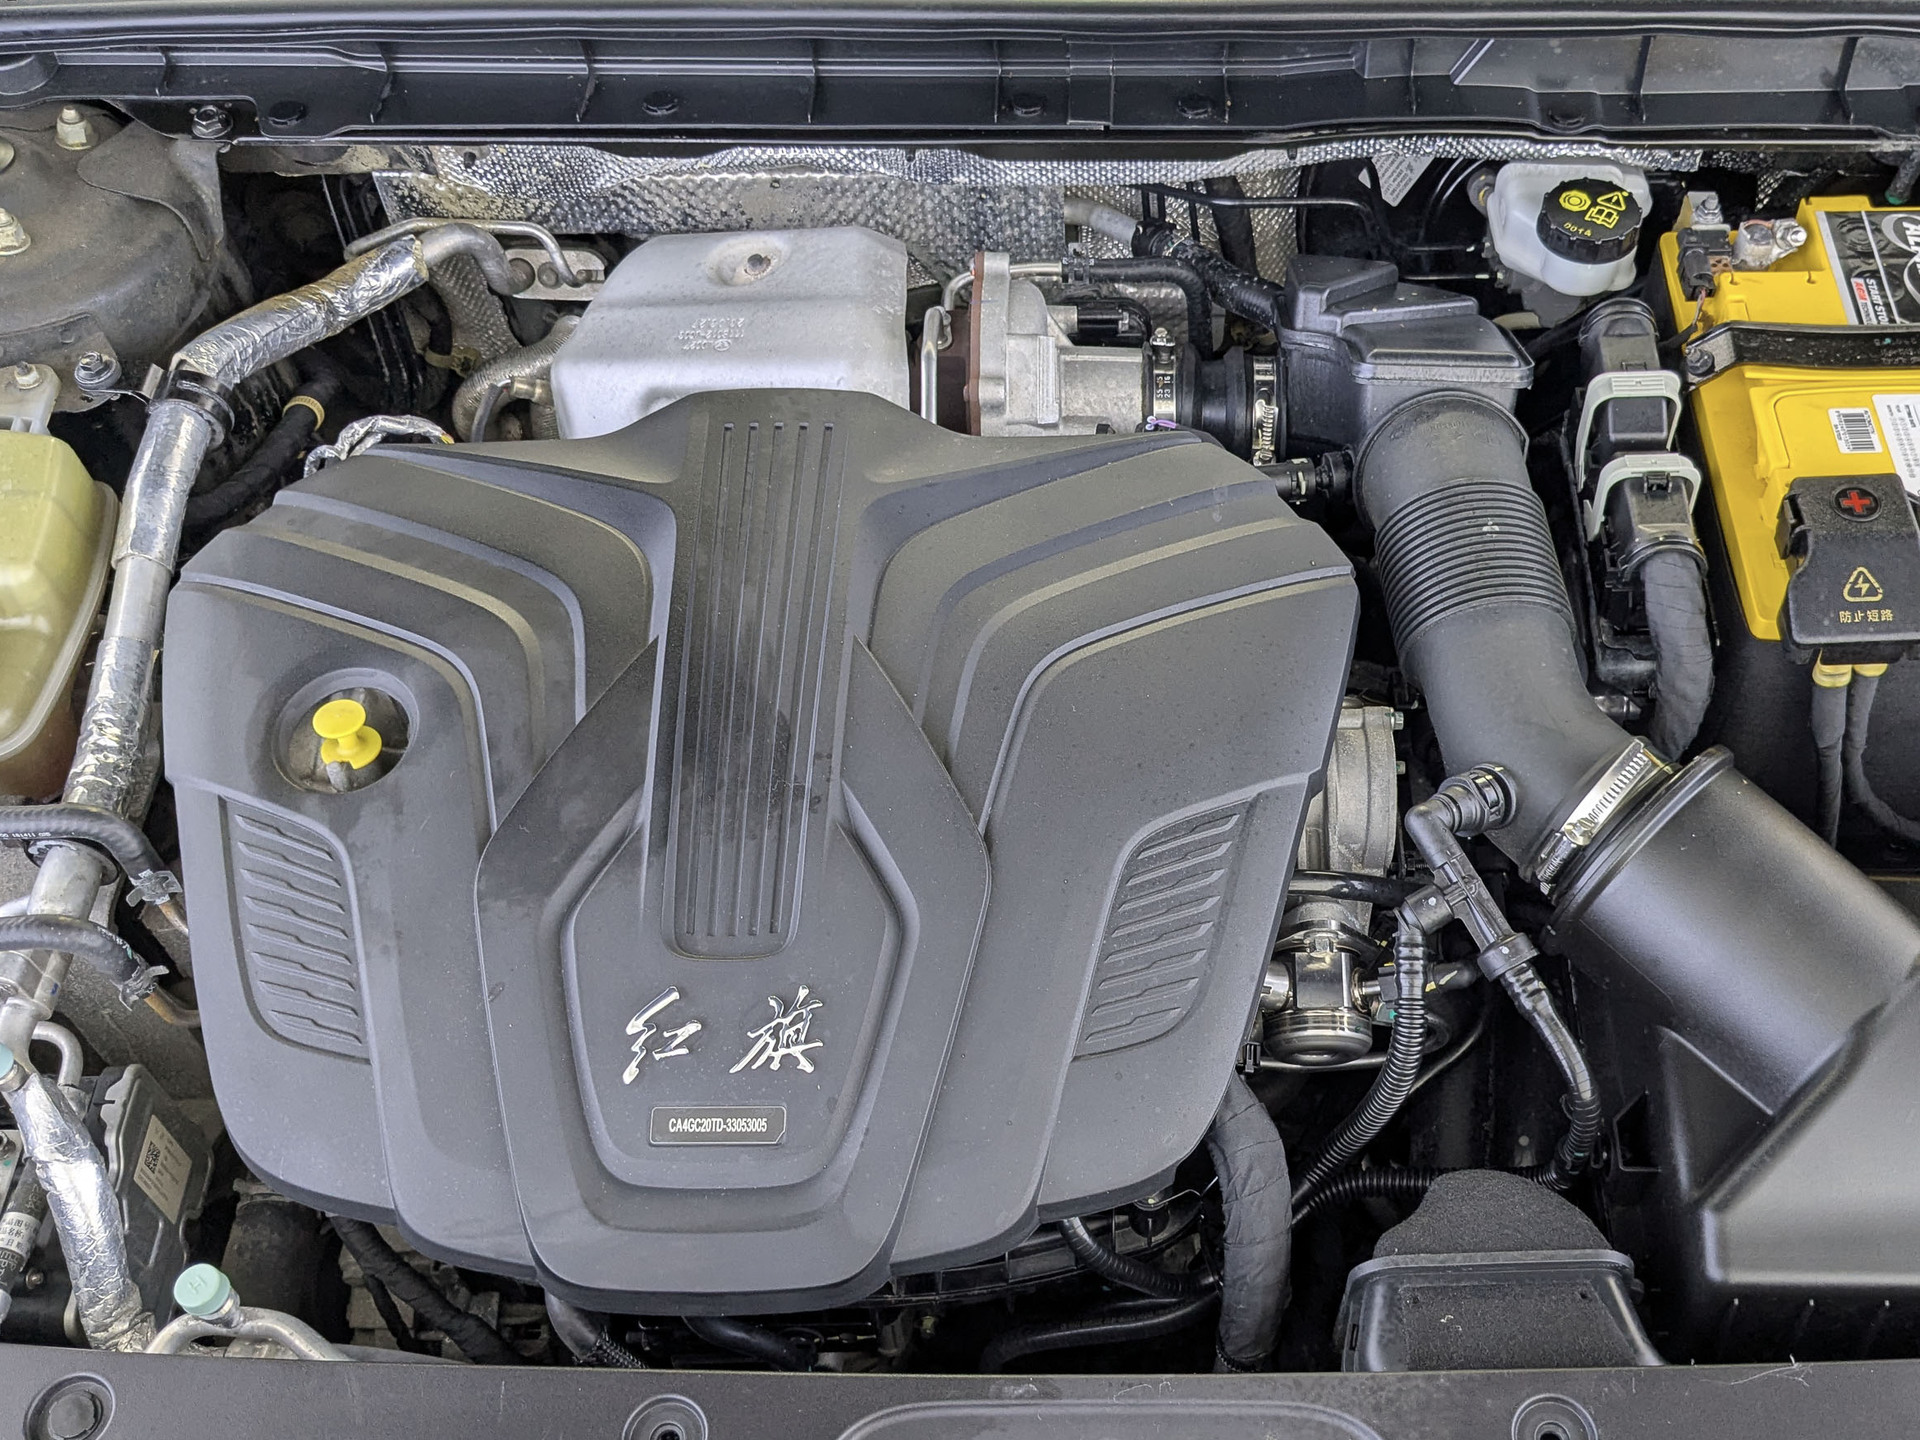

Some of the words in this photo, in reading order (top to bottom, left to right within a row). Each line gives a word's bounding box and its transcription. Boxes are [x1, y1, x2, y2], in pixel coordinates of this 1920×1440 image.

[1866, 278, 1884, 306] START
[1839, 609, 1894, 624] 防止短路
[622, 985, 823, 1085] 红旗
[668, 1117, 768, 1133] CA4GC20TD-33053005
